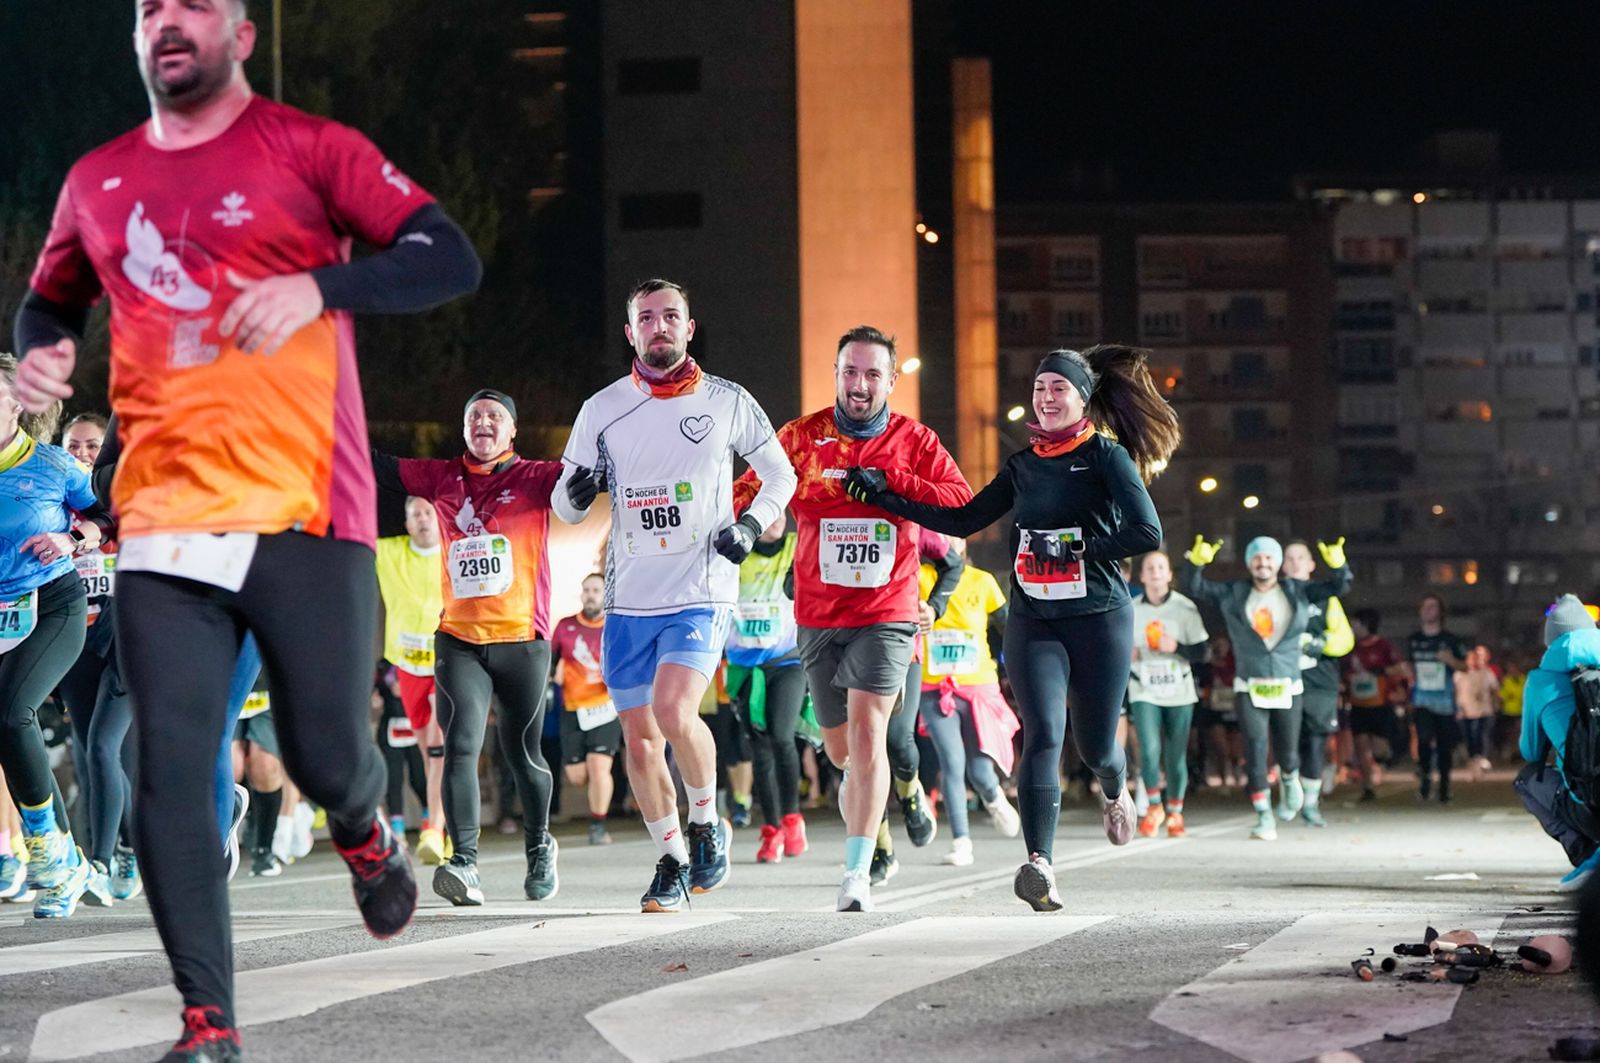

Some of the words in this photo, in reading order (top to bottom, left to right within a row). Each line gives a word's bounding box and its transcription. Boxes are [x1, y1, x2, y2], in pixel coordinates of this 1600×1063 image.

[635, 489, 657, 498] NOCHE
[658, 488, 668, 496] DE
[627, 499, 642, 508] SAN
[640, 505, 681, 530] 968
[467, 523, 481, 536] 43
[828, 534, 843, 542] SAN
[835, 543, 880, 564] 7376
[459, 556, 501, 577] 2390
[941, 644, 966, 658] 7777
